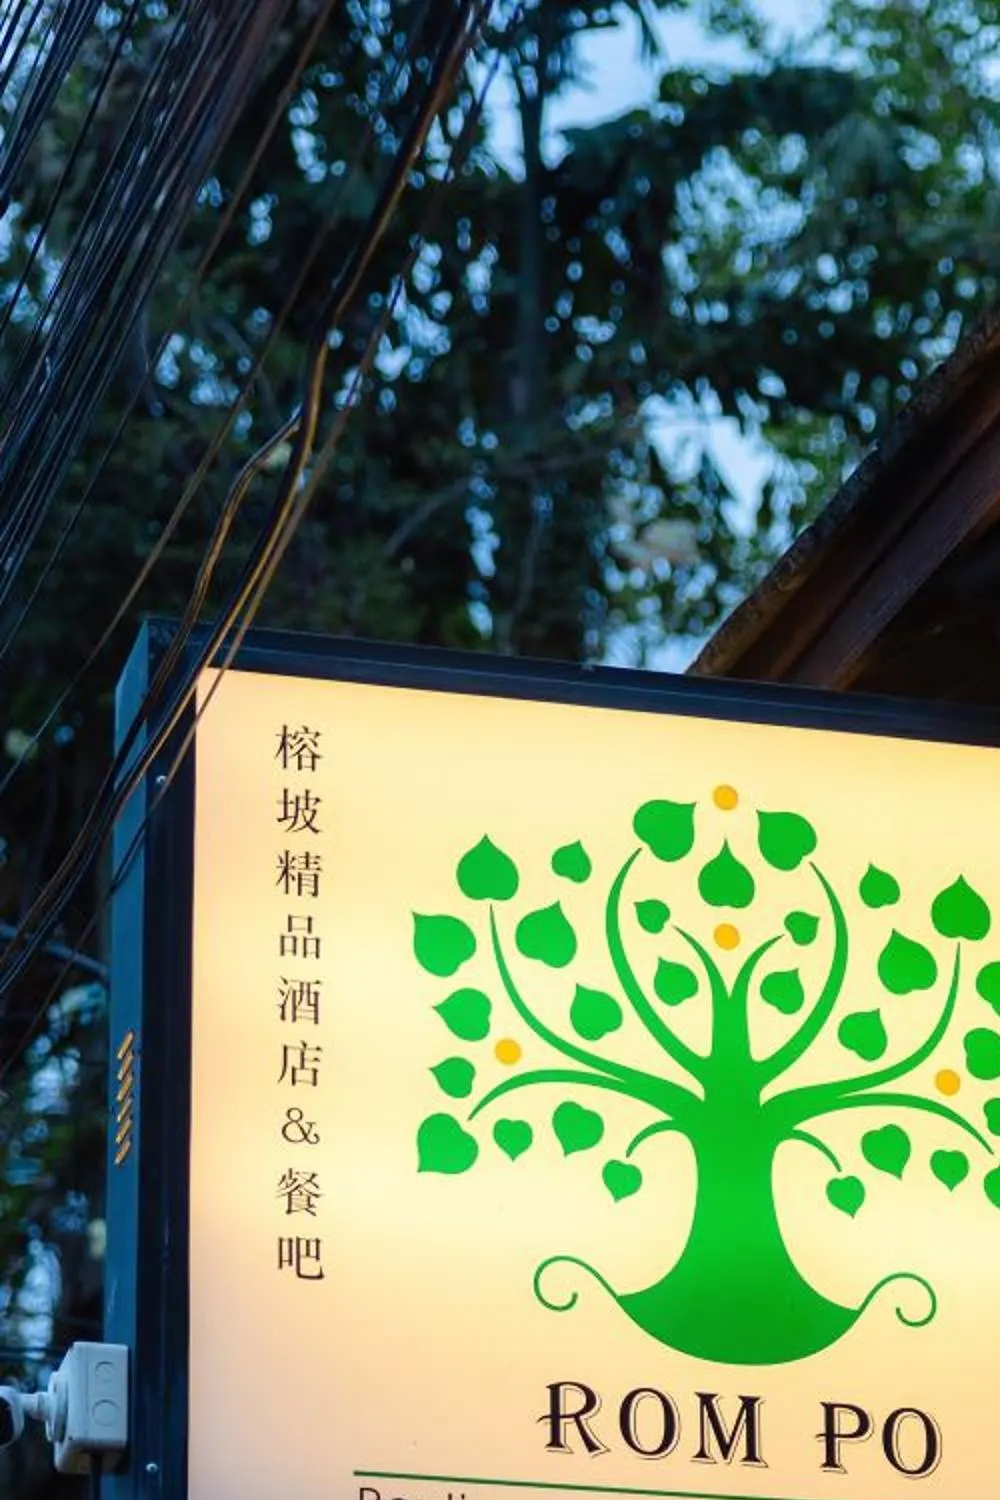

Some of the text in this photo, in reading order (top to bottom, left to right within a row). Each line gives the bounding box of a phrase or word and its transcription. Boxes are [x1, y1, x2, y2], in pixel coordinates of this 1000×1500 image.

[275, 724, 325, 1281] 榕坡精品酒店&餐吧
[536, 1381, 943, 1480] ROM PO
